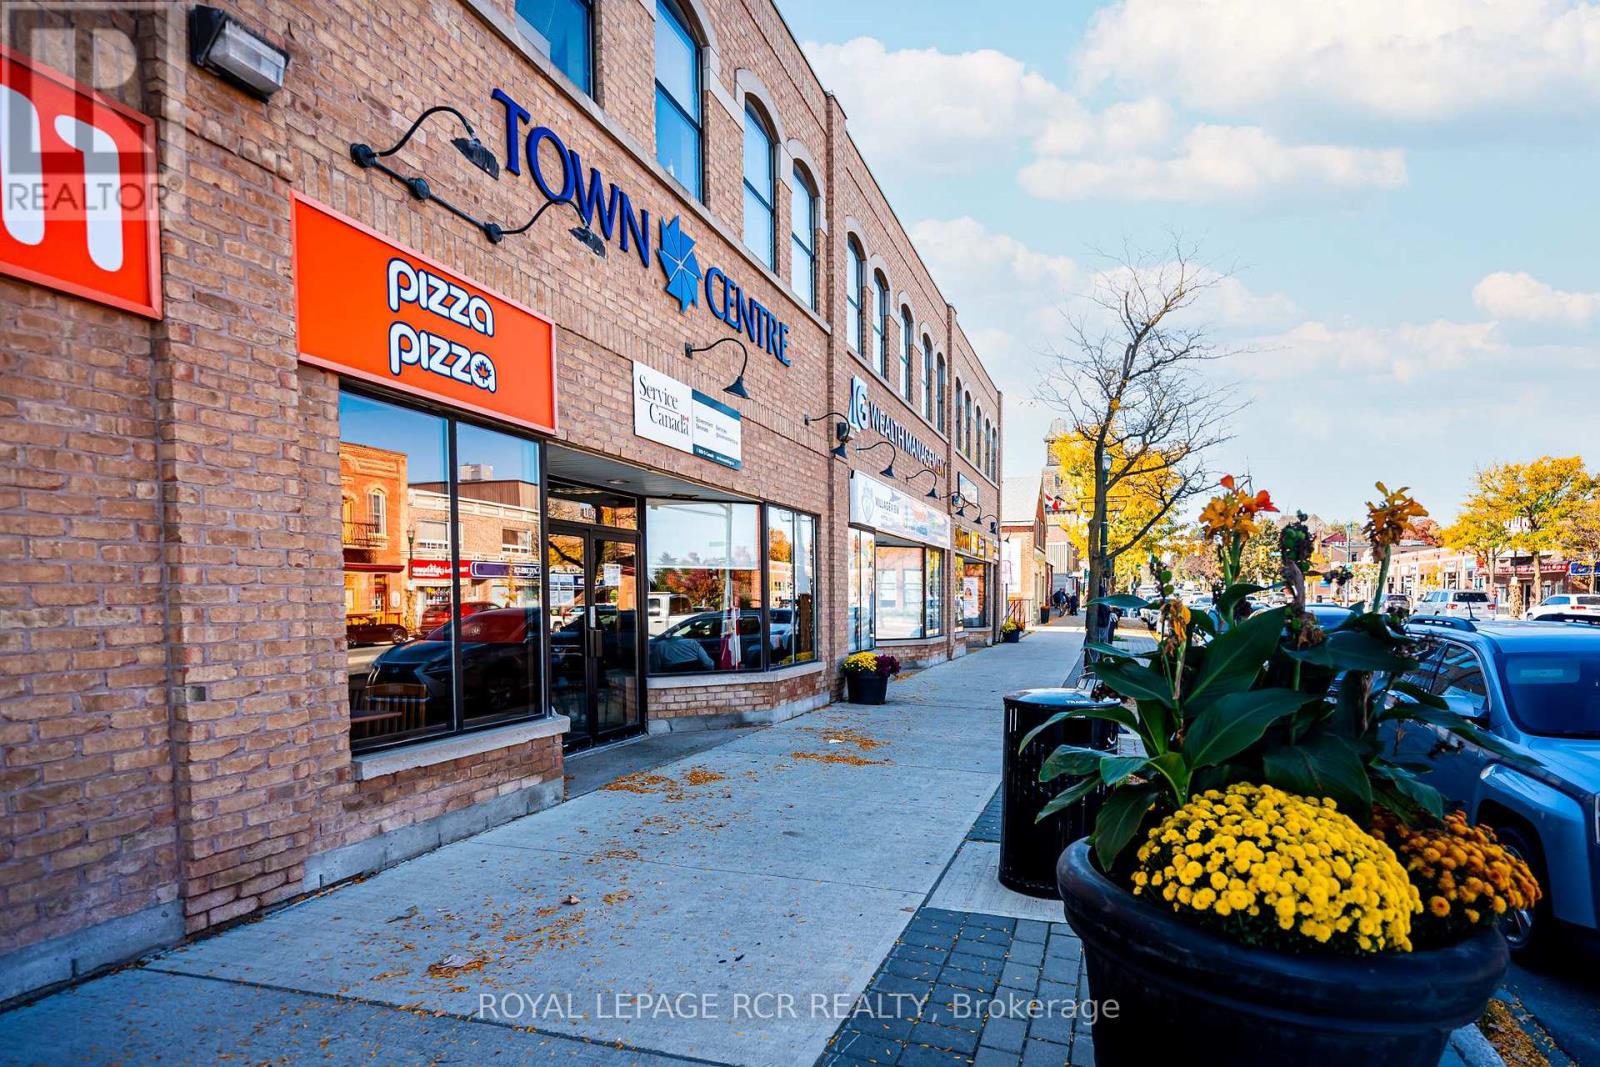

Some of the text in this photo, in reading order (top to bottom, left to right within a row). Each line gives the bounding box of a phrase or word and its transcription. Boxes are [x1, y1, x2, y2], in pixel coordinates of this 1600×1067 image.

[491, 88, 650, 268] TOWN
[705, 266, 791, 367] CENTRE
[639, 374, 679, 410] Service
[649, 402, 689, 436] Canada
[869, 401, 906, 450] WEALTH
